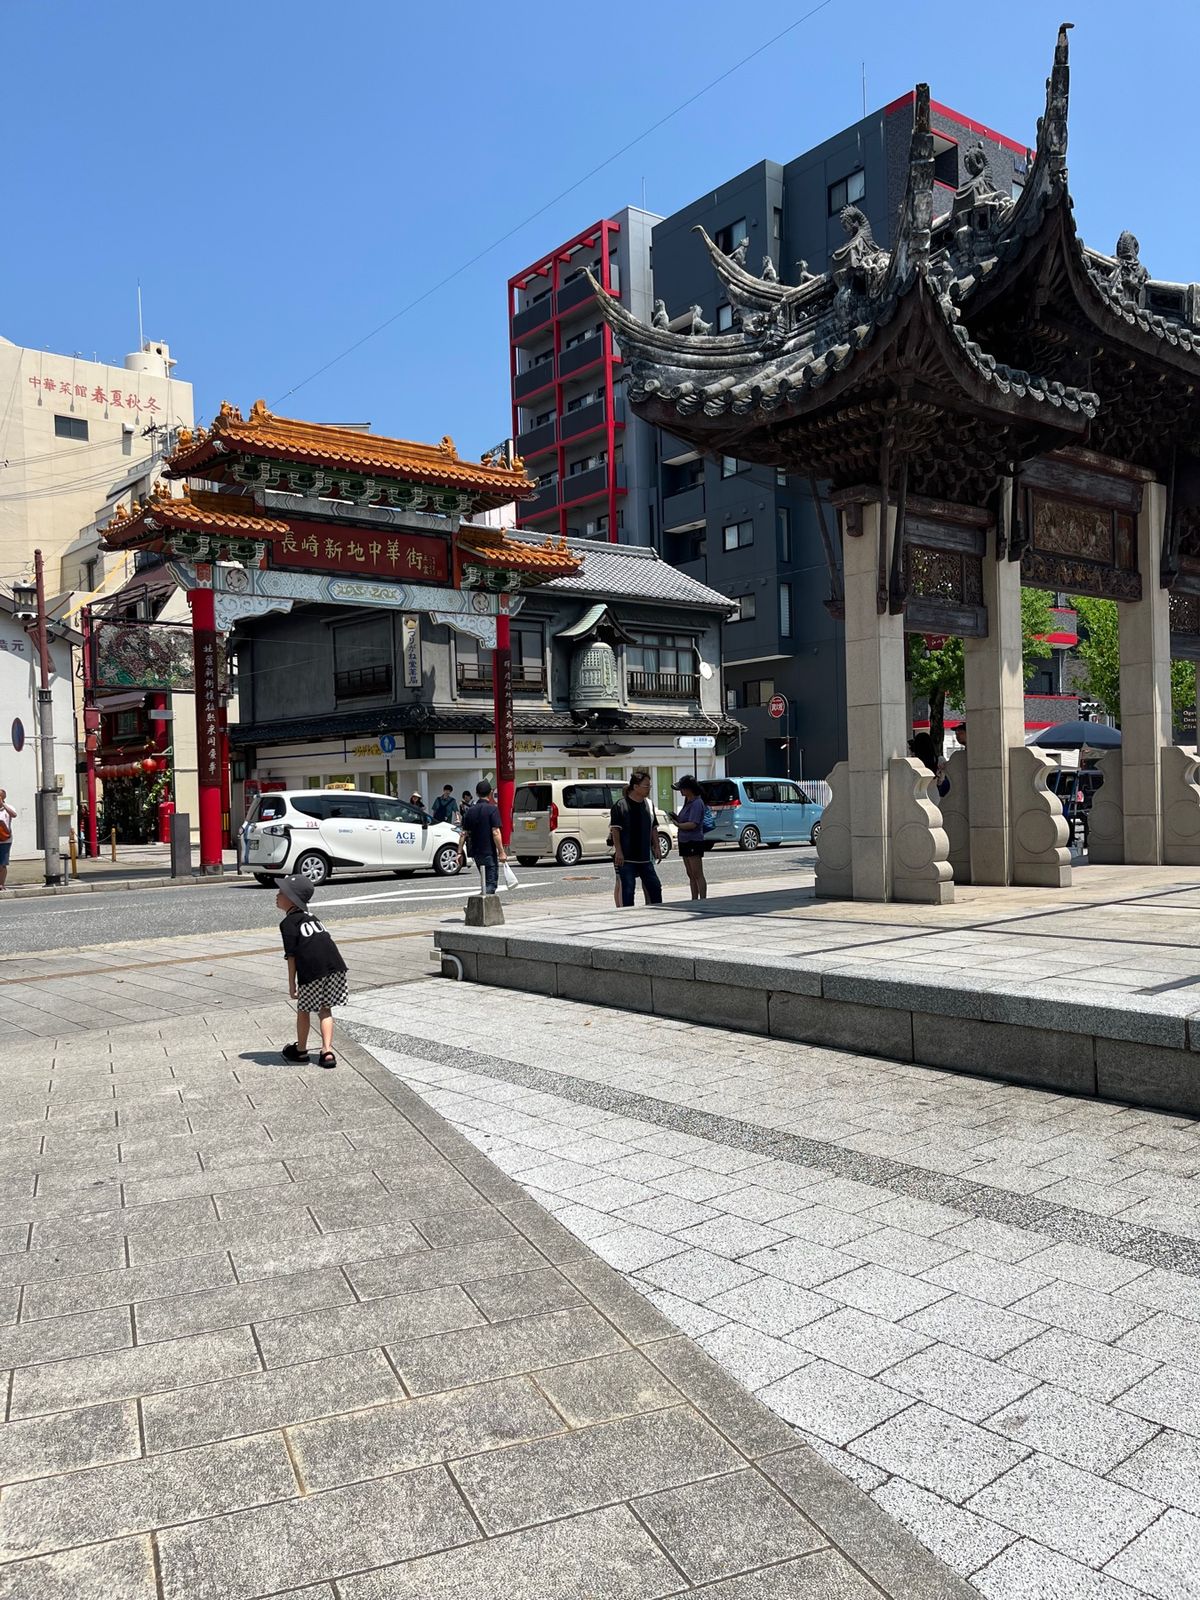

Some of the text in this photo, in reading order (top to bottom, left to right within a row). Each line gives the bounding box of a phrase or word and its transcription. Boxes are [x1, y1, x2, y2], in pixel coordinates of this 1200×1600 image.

[281, 530, 423, 571] 長崎新地中華街
[408, 630, 418, 684] つりがね堂薬局
[396, 831, 415, 839] ACE
[300, 921, 327, 937] OU
